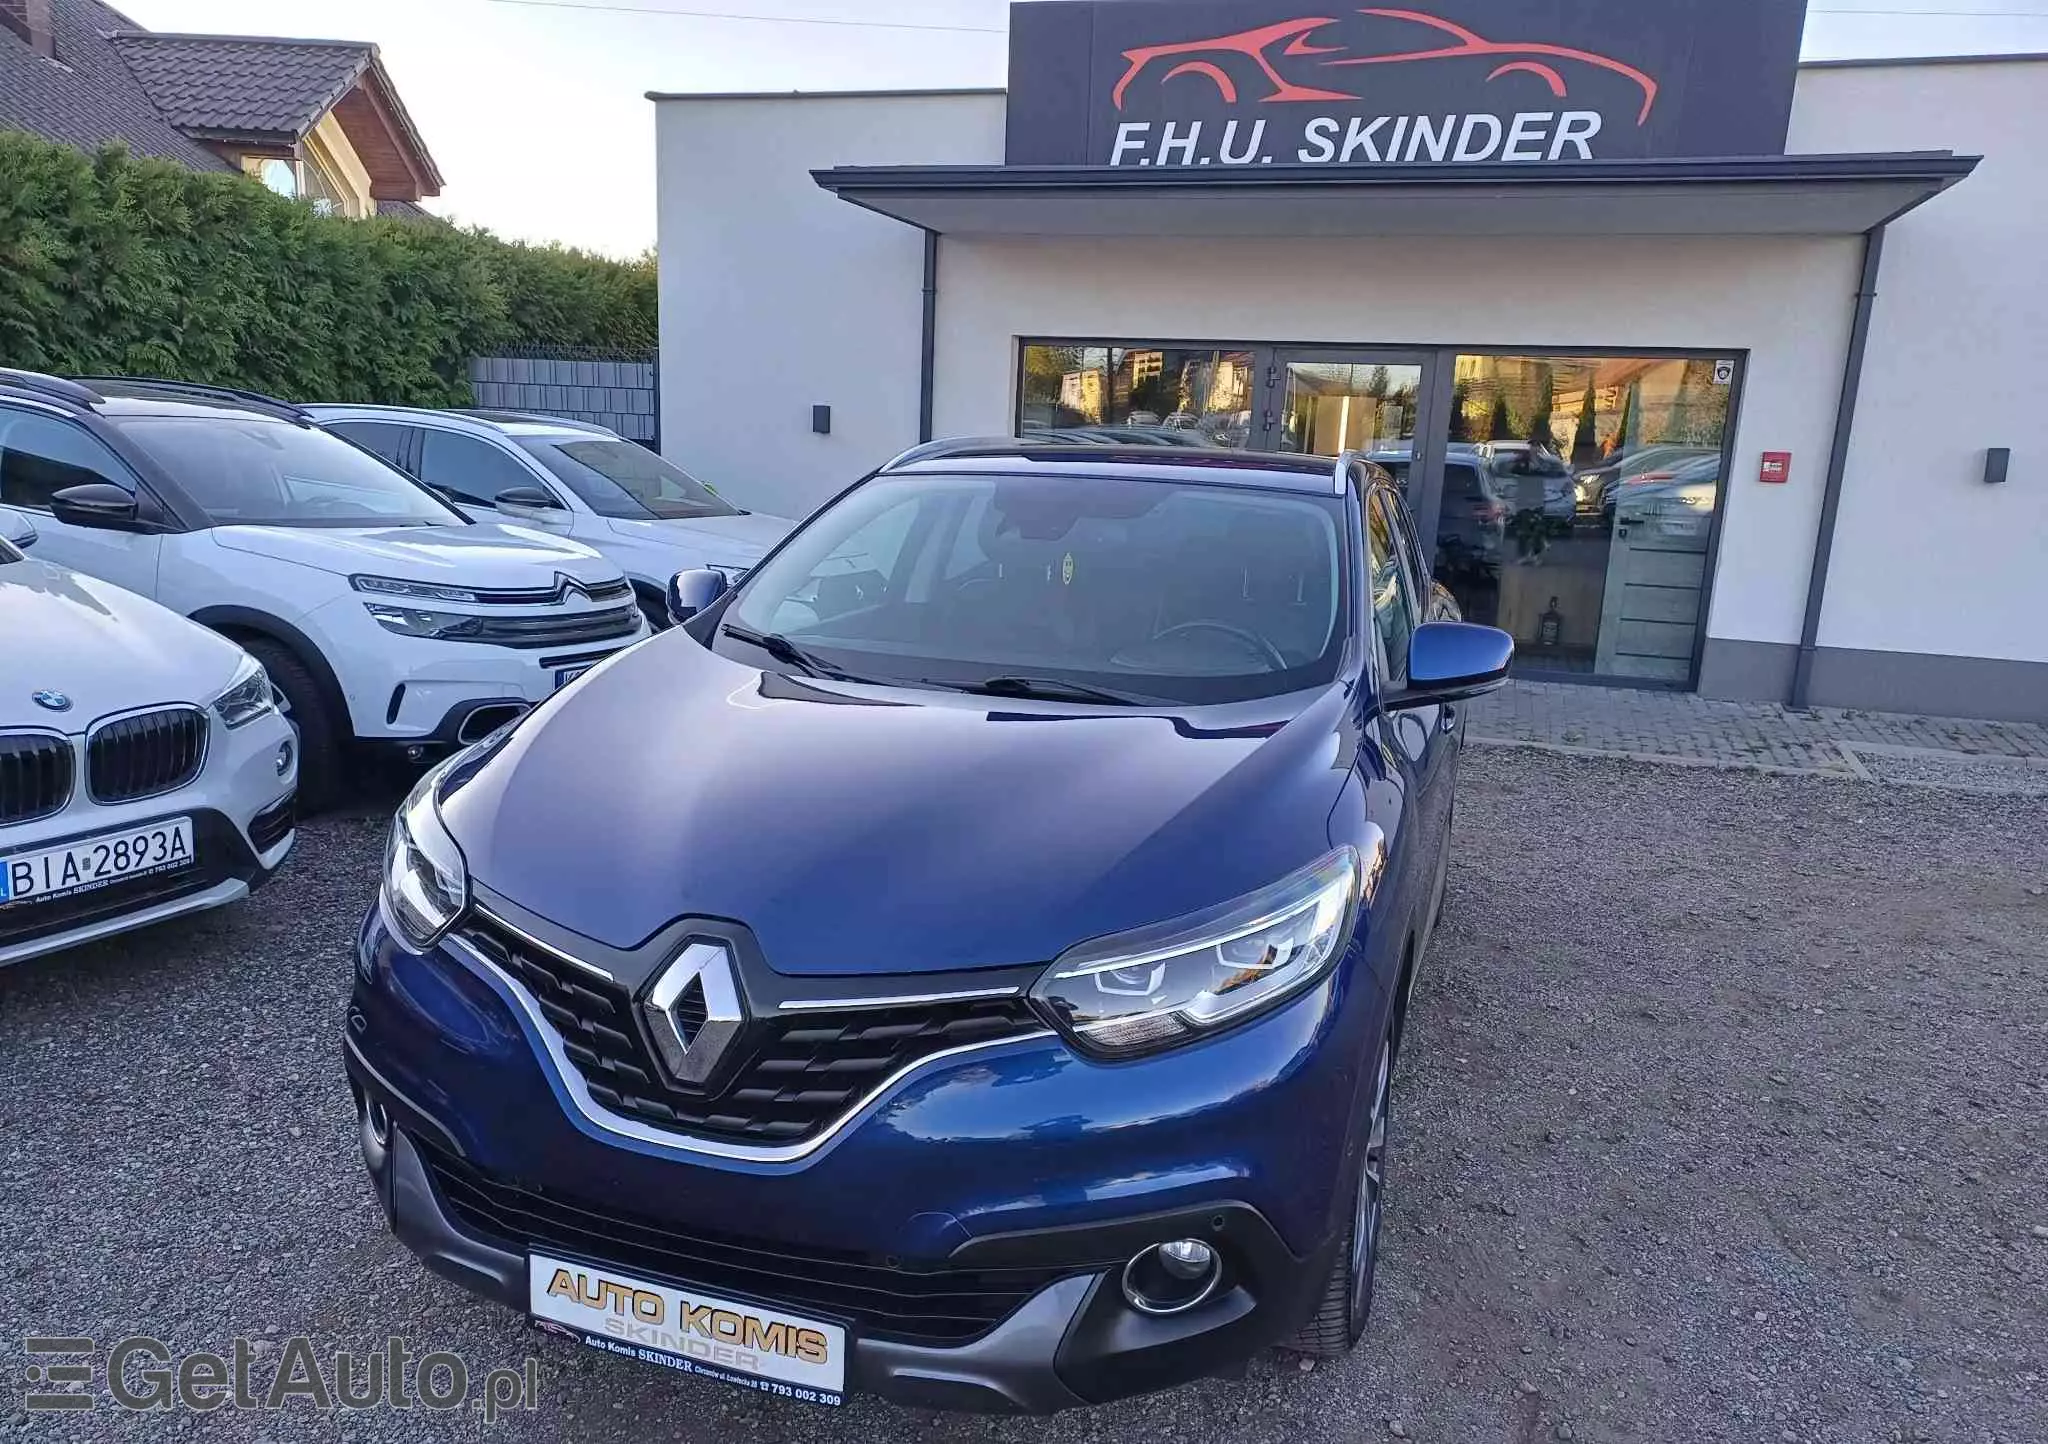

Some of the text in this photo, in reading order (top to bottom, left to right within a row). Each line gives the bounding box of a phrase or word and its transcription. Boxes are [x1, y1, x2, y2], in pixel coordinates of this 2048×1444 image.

[1109, 110, 1602, 166] F.H.U. SKINDER
[11, 826, 186, 897] BIA 2893A
[547, 1267, 829, 1366] AUTO KOMIS
[604, 1316, 760, 1371] SKINDER
[585, 1335, 606, 1350] Auto
[607, 1341, 636, 1357] Komis
[638, 1348, 693, 1373] SKINDER
[771, 1383, 793, 1397] 793
[795, 1388, 817, 1402] 002
[819, 1393, 841, 1406] 309
